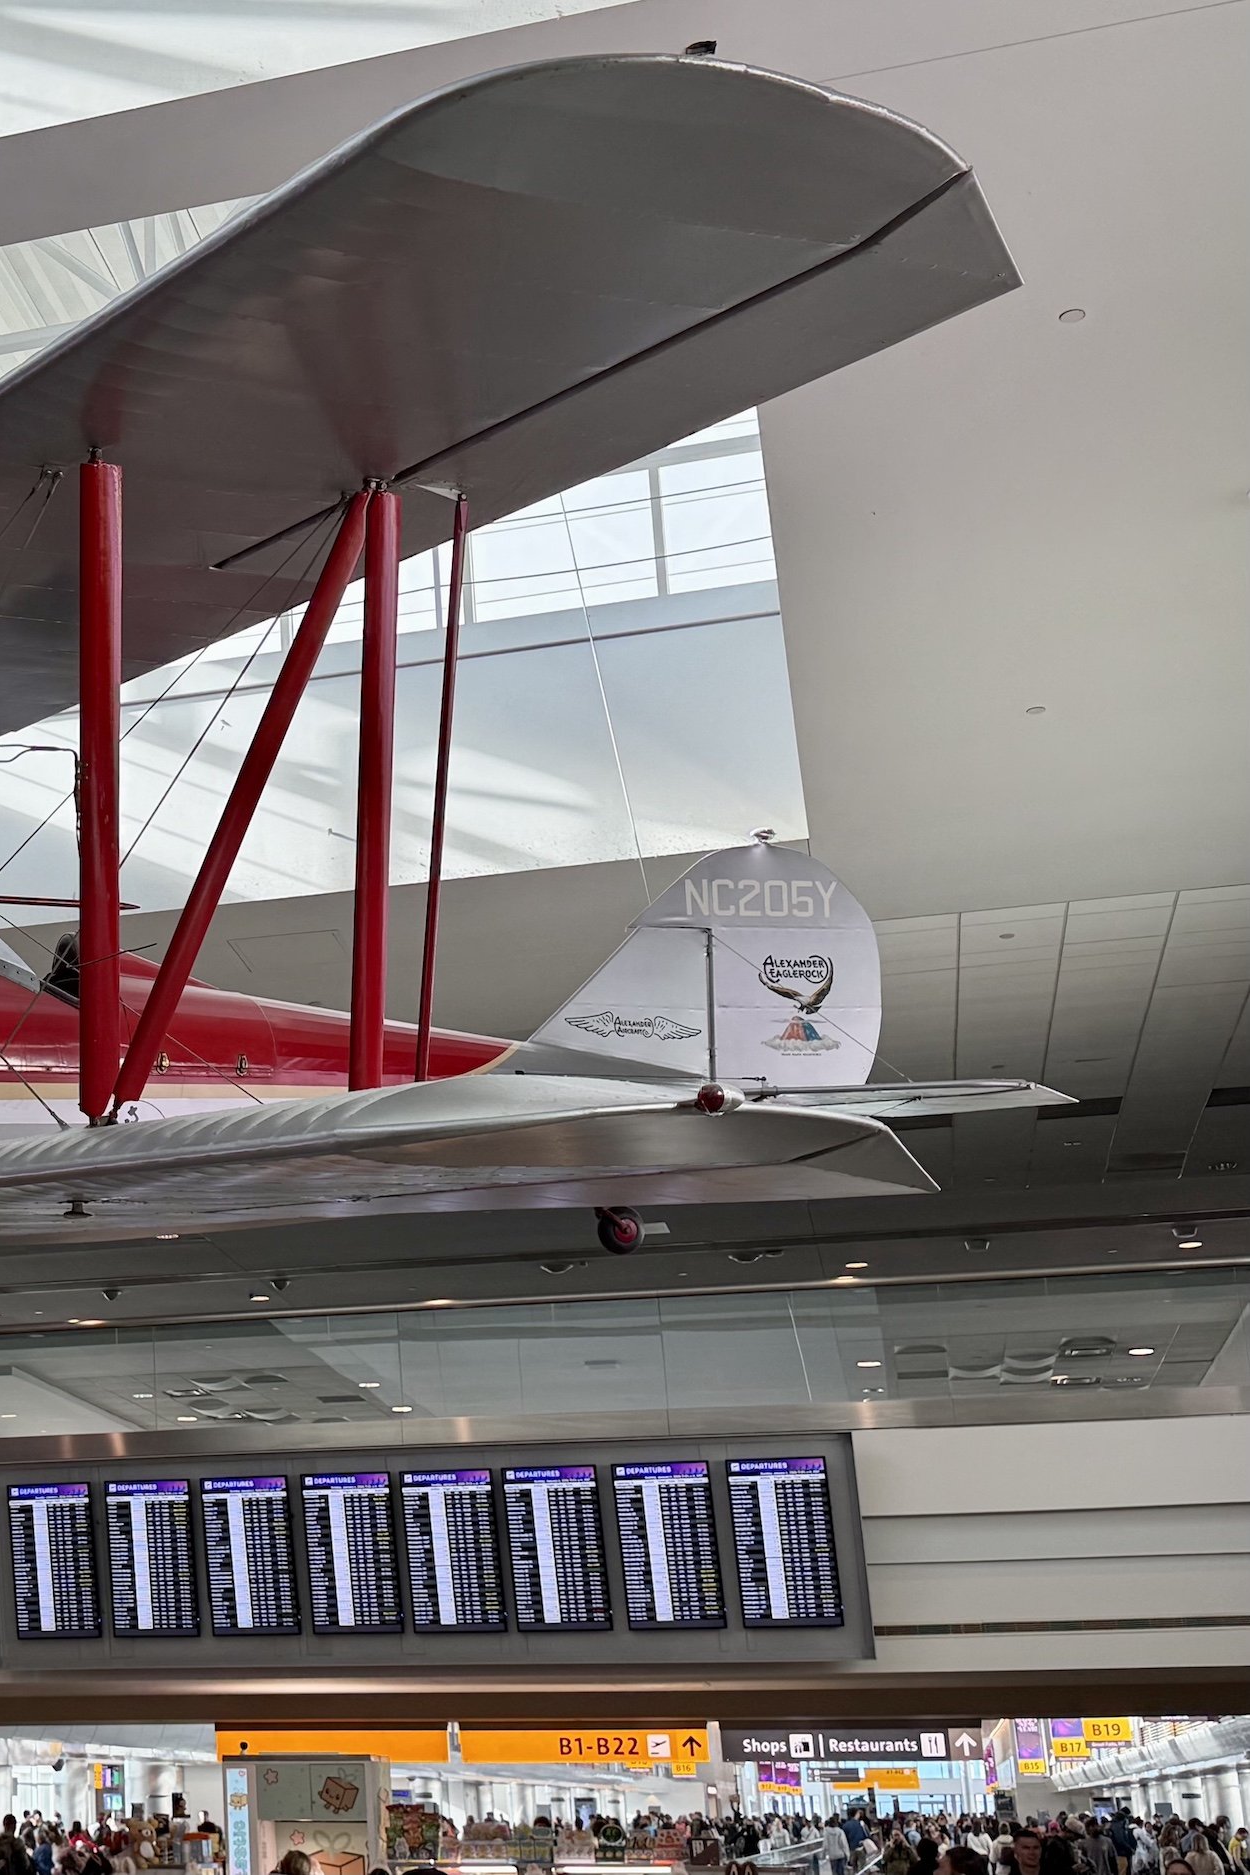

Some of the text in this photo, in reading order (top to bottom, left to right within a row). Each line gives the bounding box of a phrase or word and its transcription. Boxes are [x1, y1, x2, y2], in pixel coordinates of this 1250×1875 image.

[685, 879, 837, 918] NC205Y
[763, 955, 825, 969] ALEXANDER
[769, 968, 824, 978] EAGLEROCK
[625, 1466, 672, 1475] DEPARTURES
[740, 1462, 787, 1471] DEPARTURES
[413, 1473, 457, 1482] DEPARTURES
[515, 1470, 560, 1478] DEPARTURES
[313, 1477, 356, 1485] DEPARTURES
[19, 1487, 59, 1495] DEPARTURES
[117, 1484, 157, 1492] DEPARTURES
[1092, 1723, 1121, 1736] B19
[559, 1737, 639, 1755] B1-B22
[742, 1738, 918, 1756] Shops Restaurants
[1060, 1742, 1082, 1753] B17
[1024, 1762, 1040, 1770] B15
